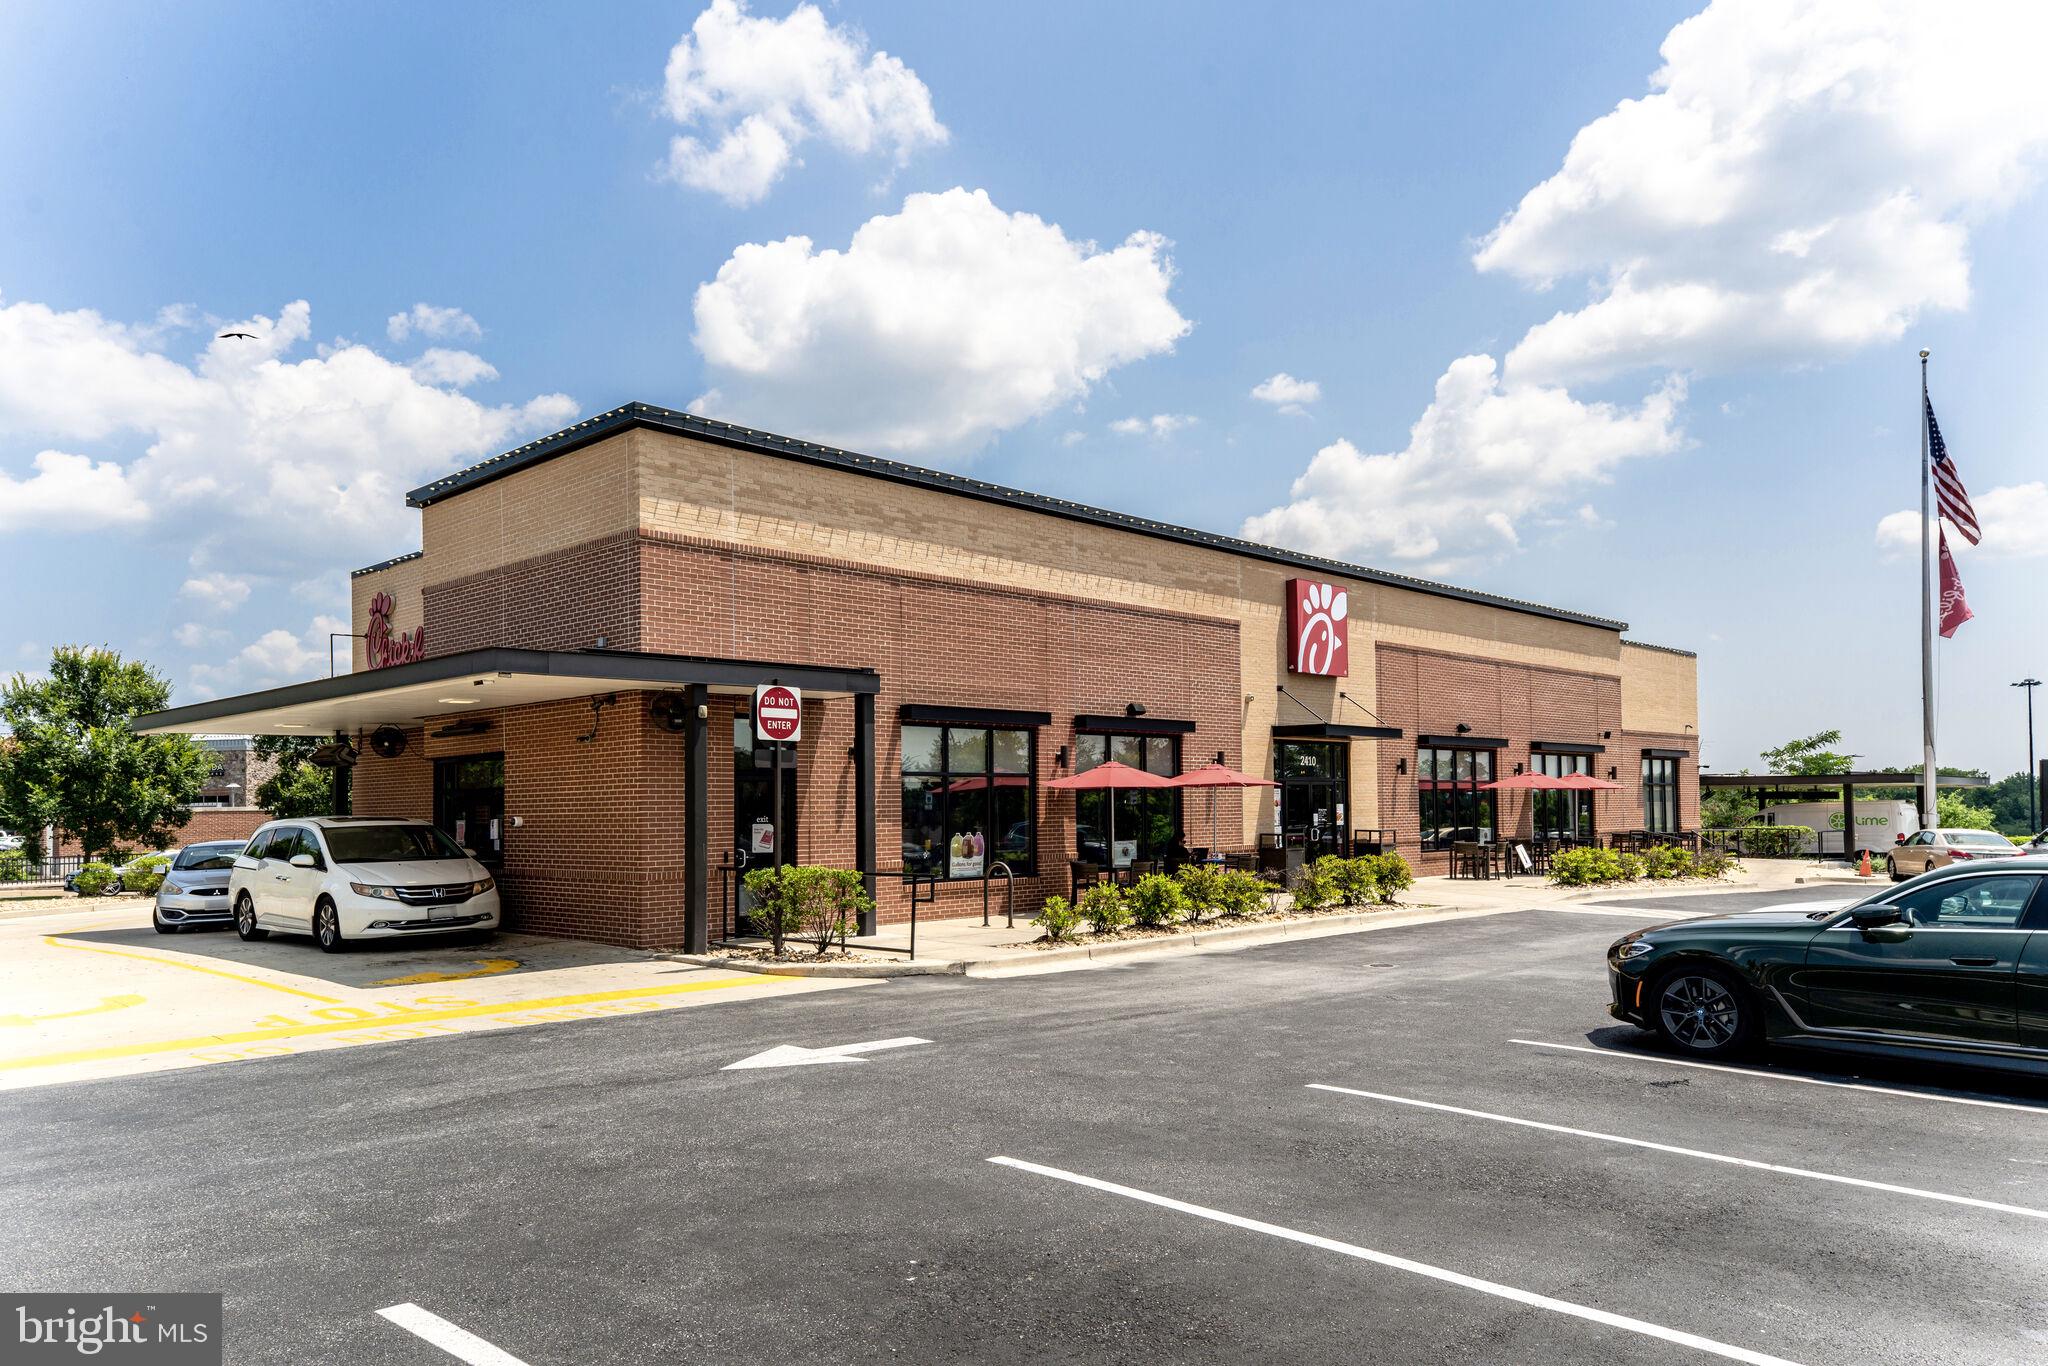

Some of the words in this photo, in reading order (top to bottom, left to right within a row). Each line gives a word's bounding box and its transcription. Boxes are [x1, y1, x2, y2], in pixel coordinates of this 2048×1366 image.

[764, 696, 776, 706] DO
[778, 697, 794, 707] NOT
[767, 720, 792, 730] ENTER
[1300, 755, 1317, 767] 2410
[756, 815, 769, 823] exit
[1855, 816, 1889, 826] Lime
[255, 995, 481, 1028] STOP
[189, 1046, 294, 1062] DO
[330, 1024, 462, 1044] NOT
